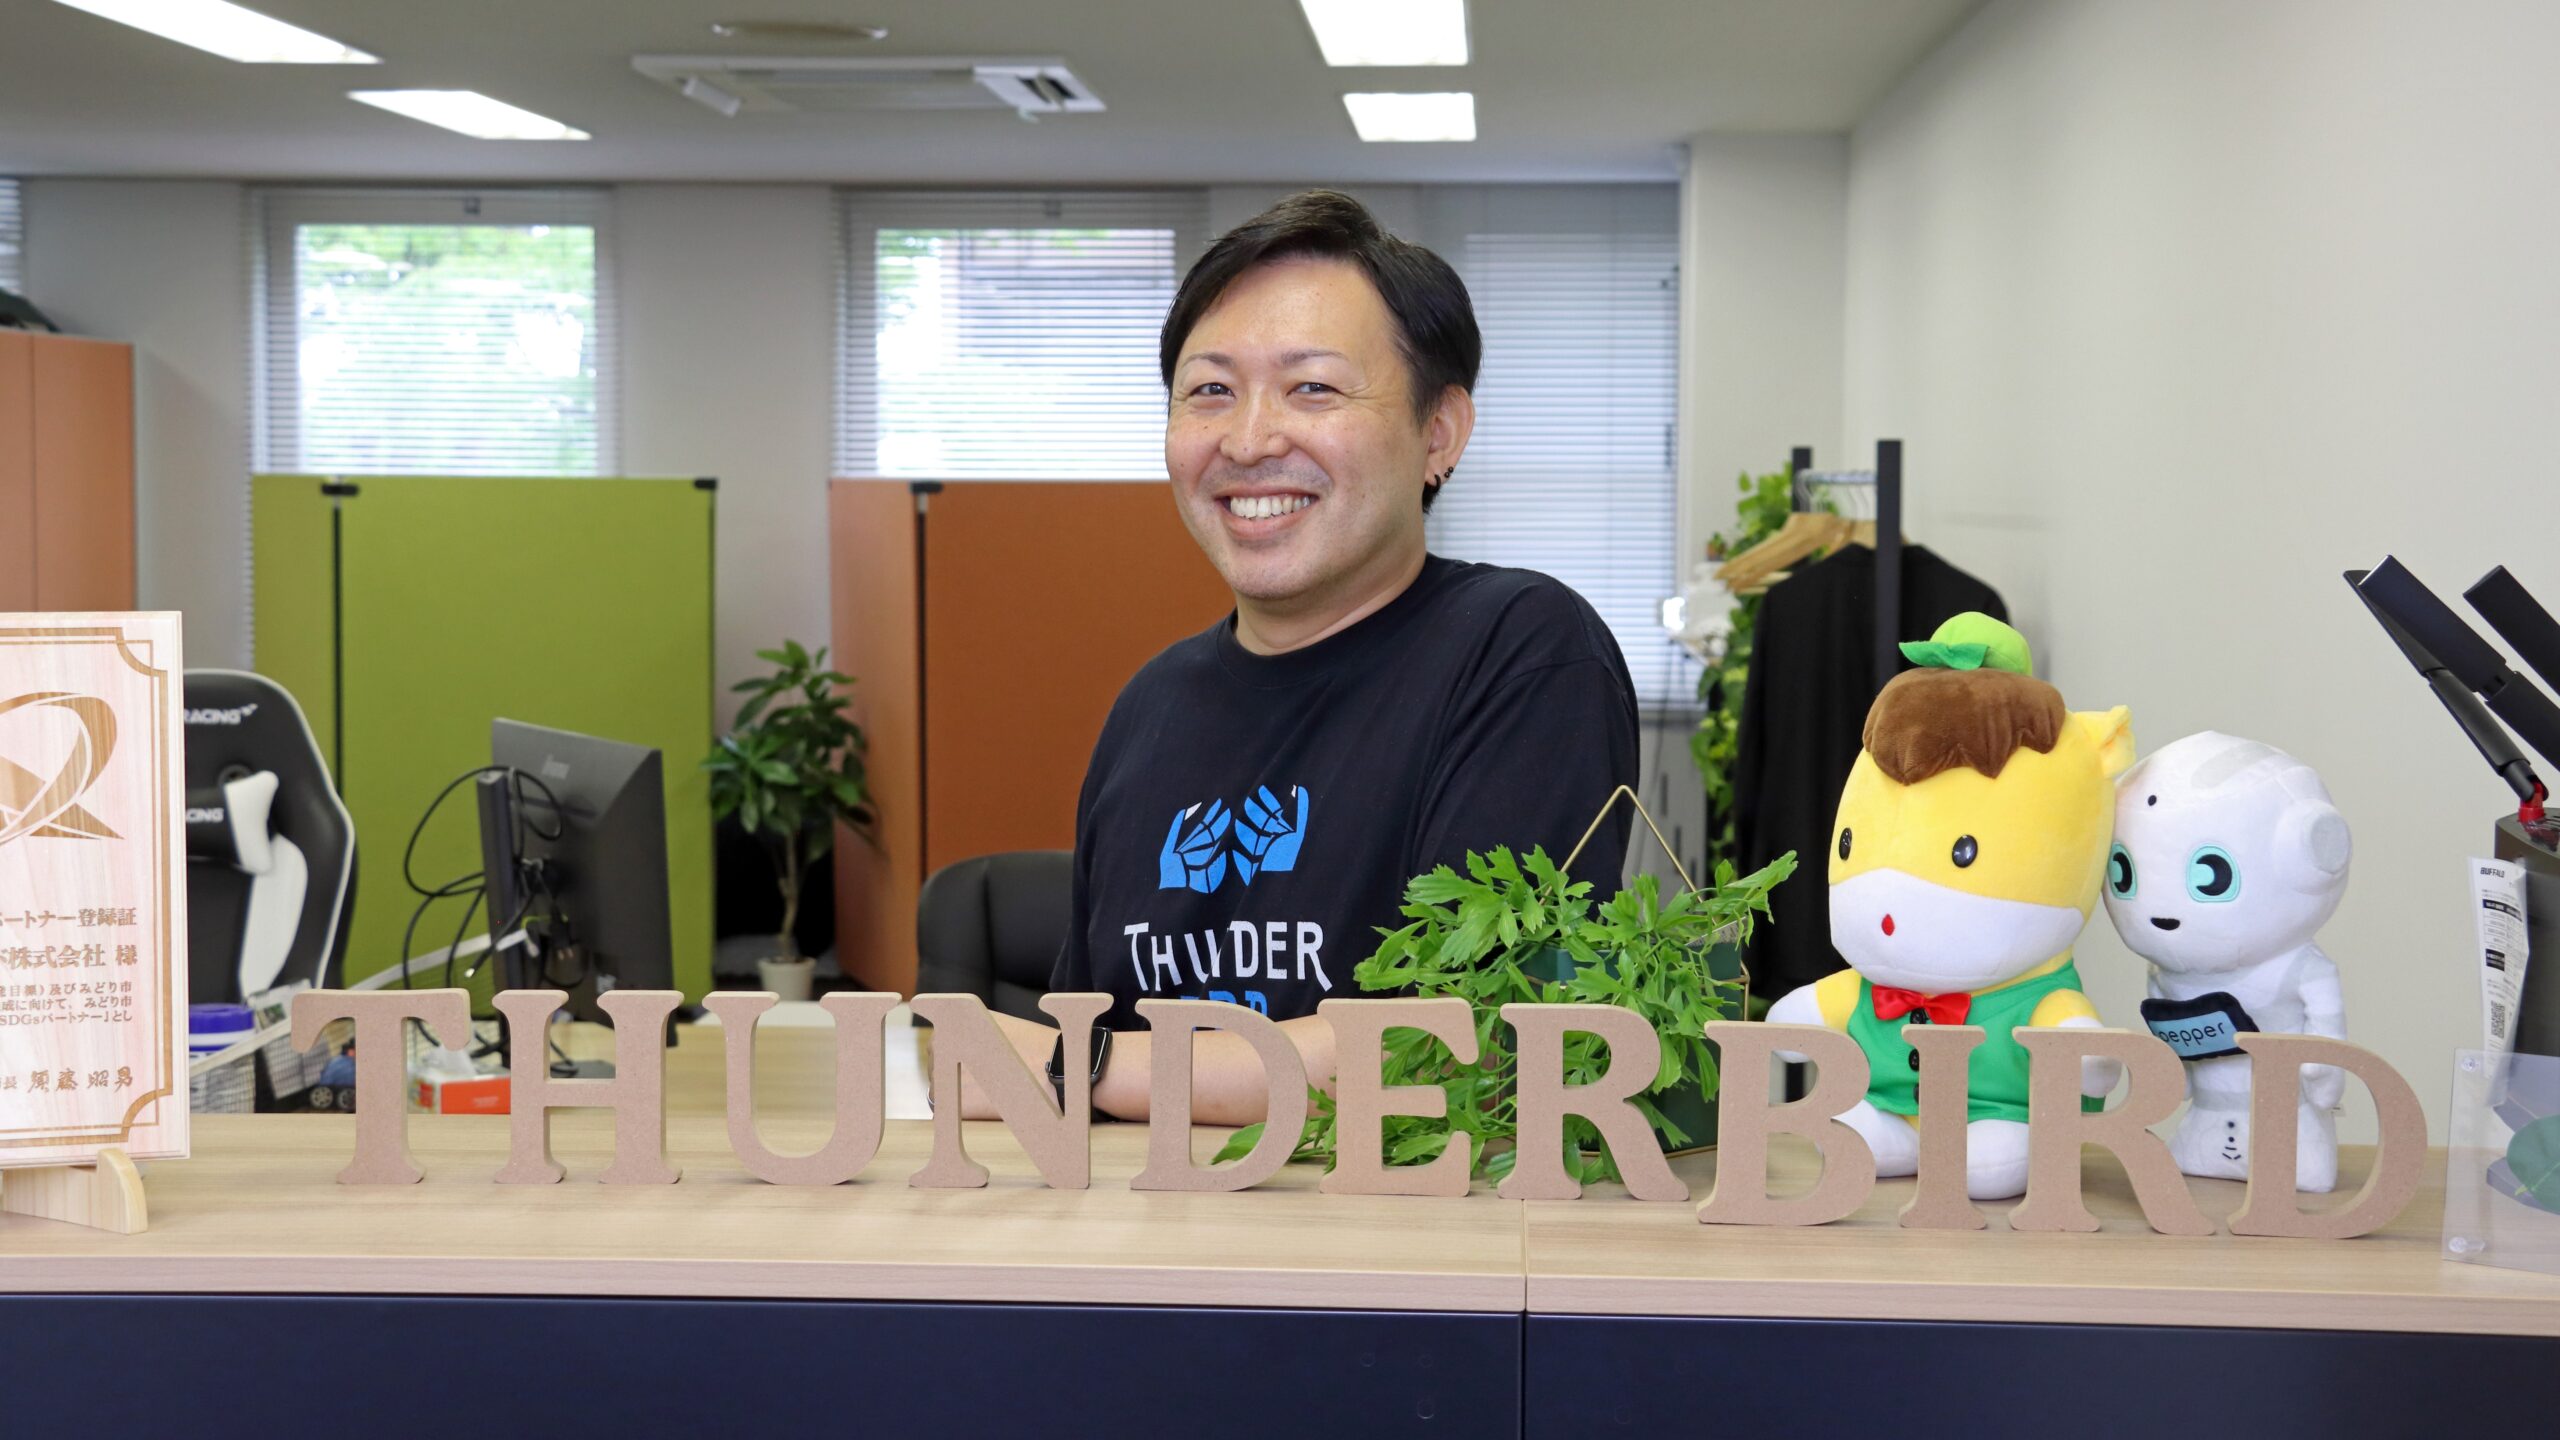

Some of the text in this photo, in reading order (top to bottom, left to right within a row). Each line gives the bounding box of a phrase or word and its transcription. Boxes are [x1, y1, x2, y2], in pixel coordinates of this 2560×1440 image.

[2480, 867, 2505, 878] BUFFALO
[0, 907, 138, 929] ートナー登録証
[291, 987, 2428, 1240] THUNDERBIRD
